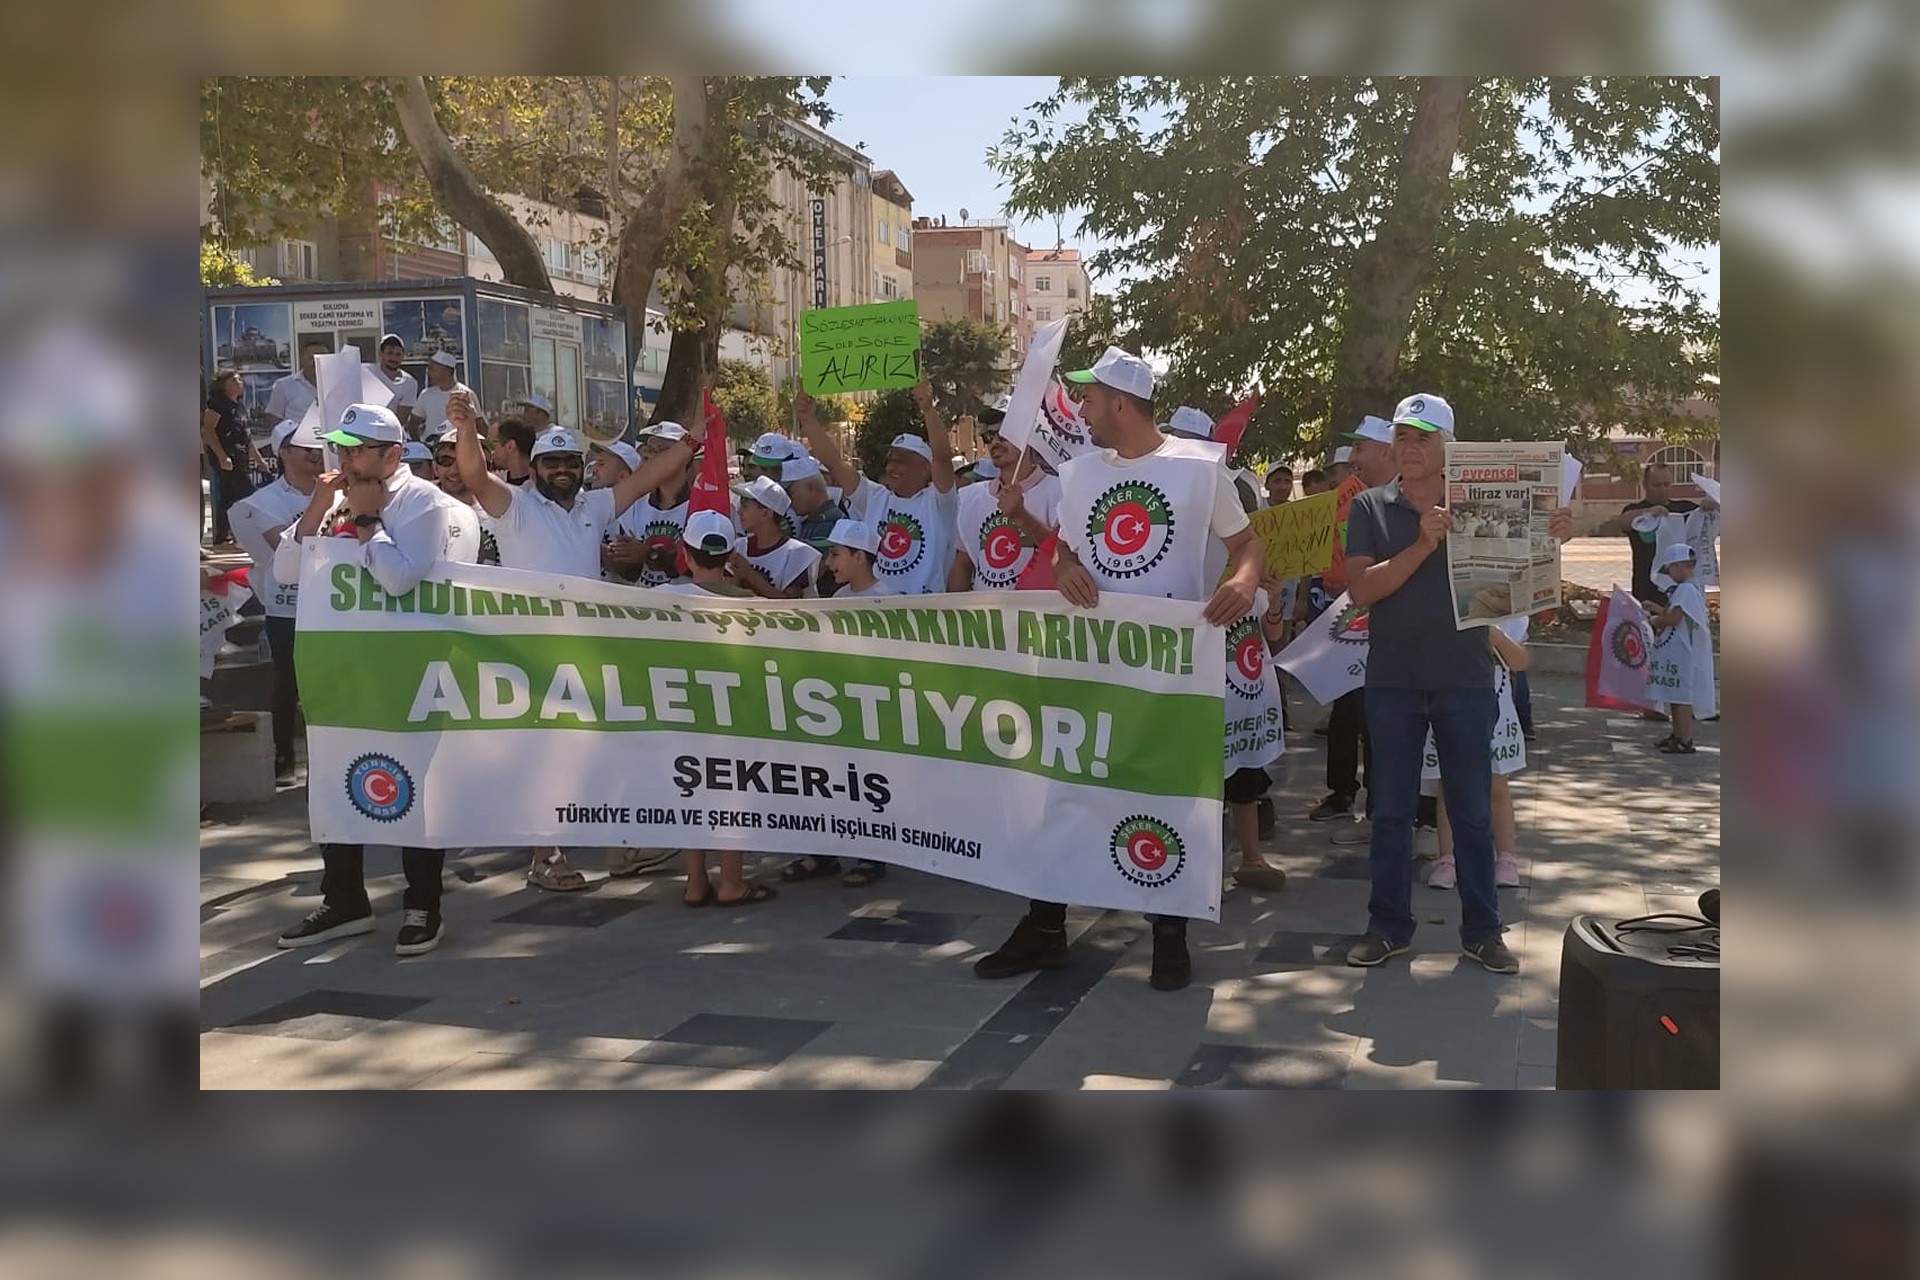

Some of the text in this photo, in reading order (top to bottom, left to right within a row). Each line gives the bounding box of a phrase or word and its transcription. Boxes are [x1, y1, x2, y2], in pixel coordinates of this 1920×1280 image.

[814, 202, 827, 309] OTEL PARI
[818, 348, 920, 388] ALIRIZ!
[1462, 466, 1519, 480] evrensel
[1469, 485, 1501, 500] İtiraz
[1505, 487, 1530, 500] var!
[1106, 554, 1146, 568] 1963
[1017, 609, 1195, 676] ARIYOR!
[407, 660, 1112, 779] ADALET İSTİYOR!
[1225, 715, 1263, 738] EKER
[673, 755, 892, 813] ŞEKER-İŞ
[555, 803, 982, 860] TÜRKİYE GIDA VE ŞEKER SANAYİ İŞÇİLERİ SENDİKASI
